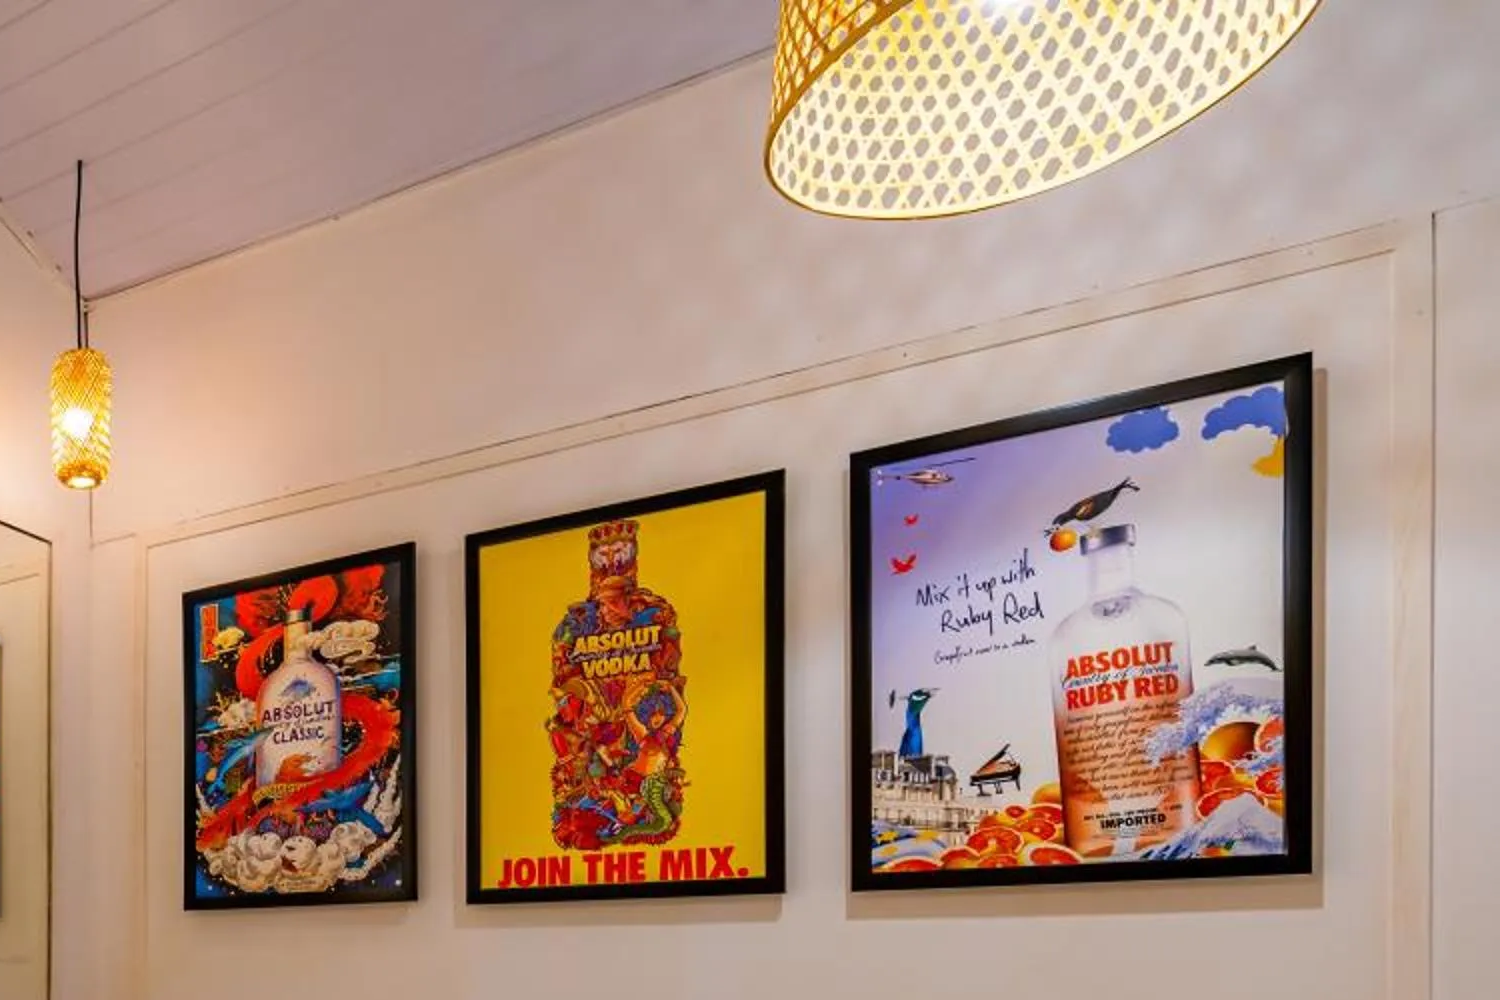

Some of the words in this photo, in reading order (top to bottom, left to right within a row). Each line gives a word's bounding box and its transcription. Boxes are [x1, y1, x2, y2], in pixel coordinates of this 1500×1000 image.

[916, 584, 950, 606] Mix
[957, 573, 969, 599] it
[976, 577, 997, 602] up
[1001, 548, 1035, 583] with
[941, 605, 993, 636] Ruby
[1003, 592, 1044, 624] Red
[575, 625, 661, 654] ABSOLUT
[582, 652, 651, 679] VODKA
[1066, 642, 1173, 678] ABSOLUT
[1066, 680, 1128, 711] RUBY
[1134, 674, 1179, 699] RED
[262, 701, 334, 722] ABSOLUT
[1100, 813, 1167, 829] IMPORTED
[498, 856, 571, 889] JOIN
[583, 852, 646, 884] THE
[659, 846, 750, 880] MIX.
